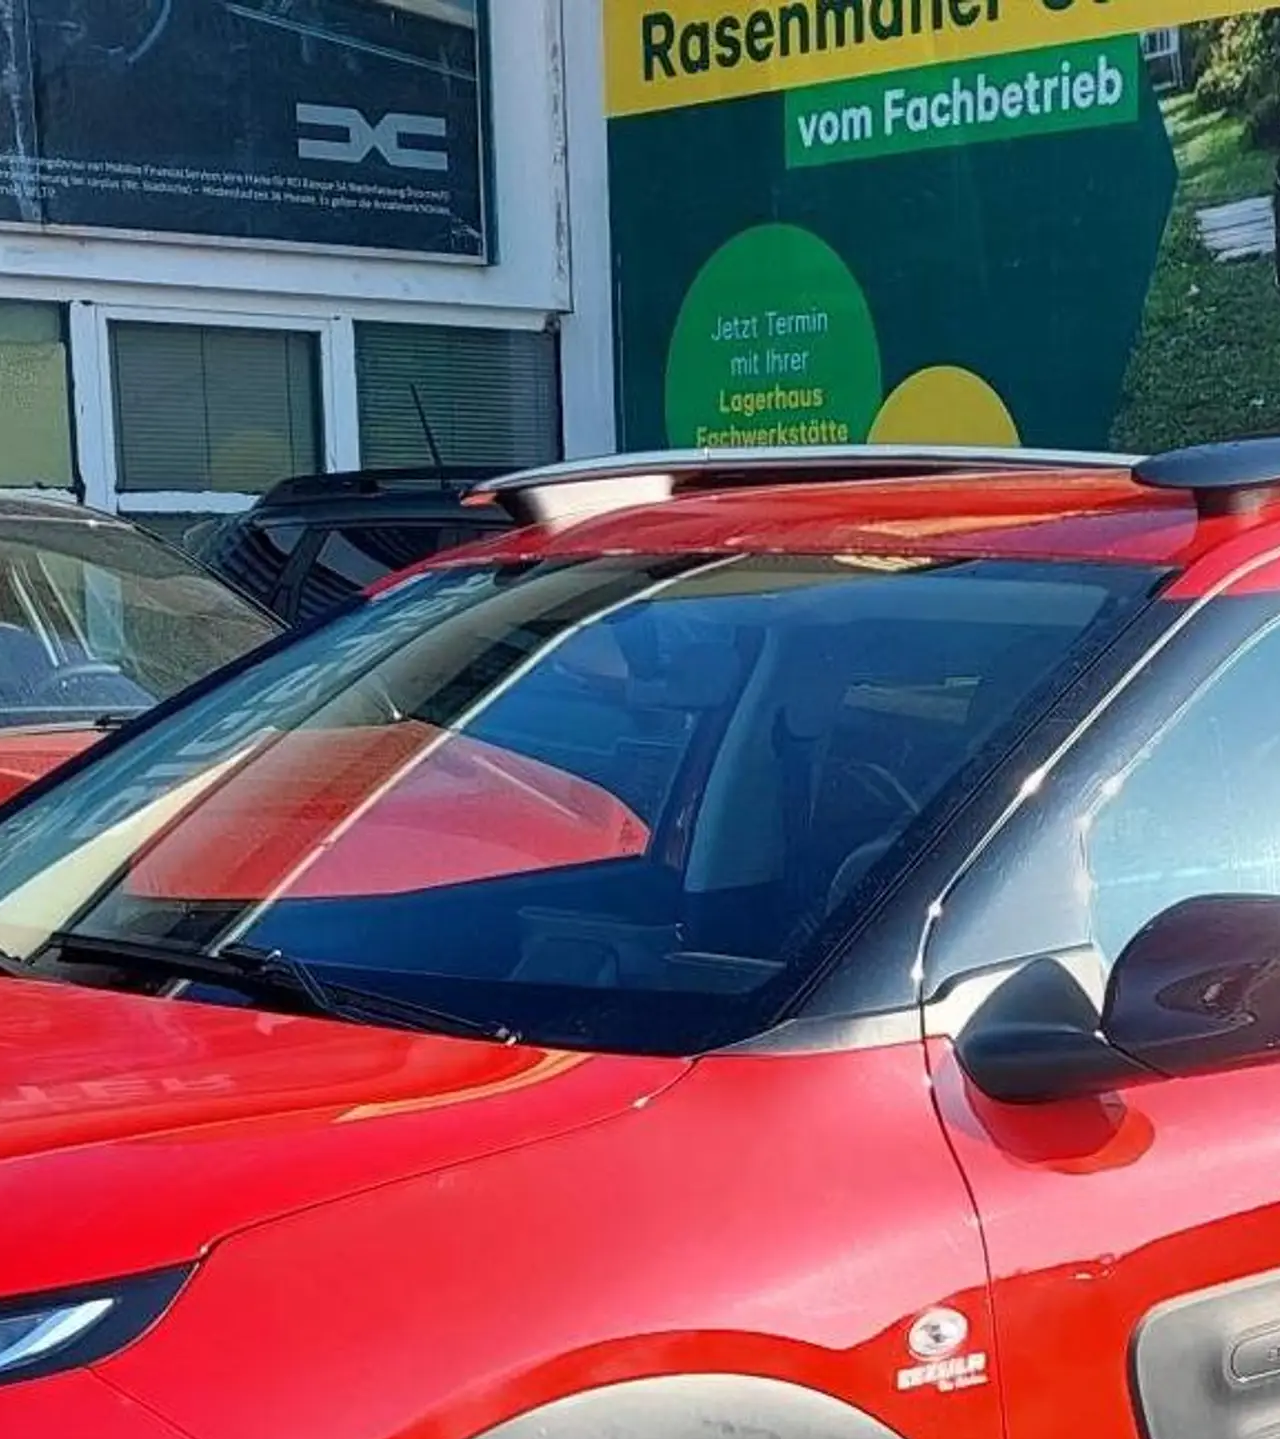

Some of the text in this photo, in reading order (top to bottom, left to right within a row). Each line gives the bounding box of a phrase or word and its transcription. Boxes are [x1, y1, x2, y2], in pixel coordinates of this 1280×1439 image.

[798, 55, 1123, 147] vom Fachbetrieb
[711, 308, 828, 341] Jetzt Termin
[731, 349, 809, 376] mit Ihrer
[719, 383, 824, 417] Lagerhaus
[696, 419, 849, 447] Fachwerkstätte
